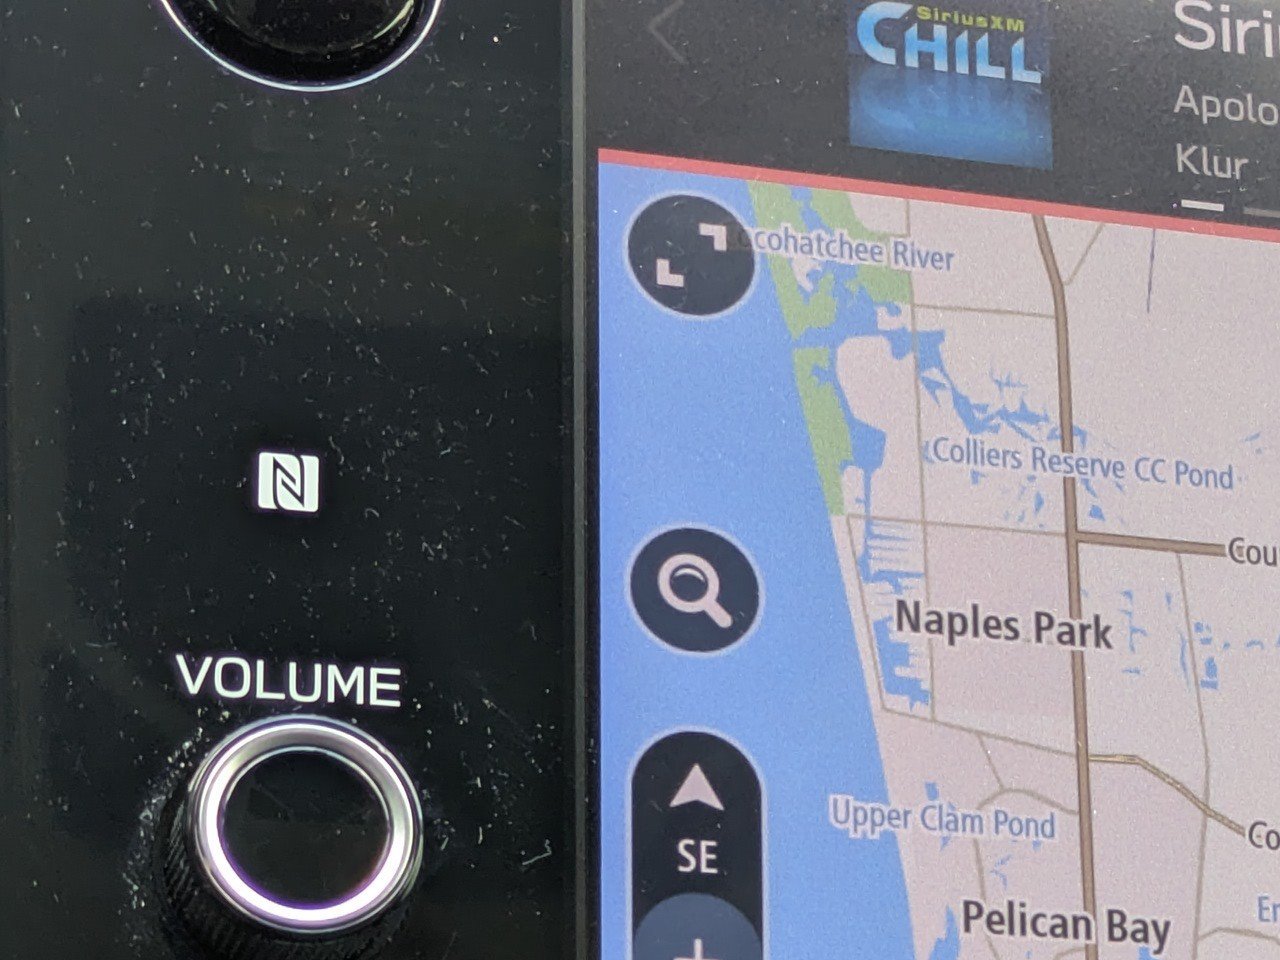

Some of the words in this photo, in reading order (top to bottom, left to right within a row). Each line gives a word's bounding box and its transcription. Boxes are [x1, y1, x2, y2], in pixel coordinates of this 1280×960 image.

[856, 1, 1042, 84] CHILL
[917, 5, 1026, 33] SiriusXM
[1175, 142, 1250, 181] Klur
[738, 226, 884, 264] cohatchee
[892, 239, 956, 272] River
[932, 436, 1023, 470] Colliers
[1031, 446, 1126, 480] Reserve
[1134, 456, 1167, 484] CC
[1174, 460, 1235, 490] Pond
[895, 599, 1020, 646] Naples
[1035, 610, 1114, 651] Park
[174, 653, 402, 708] VOLUME
[831, 797, 910, 834] Upper
[920, 801, 984, 835] Clam
[994, 809, 1056, 840] Pond
[677, 839, 719, 875] SE
[961, 899, 1094, 943] Pelican
[1106, 909, 1172, 954] Bay
